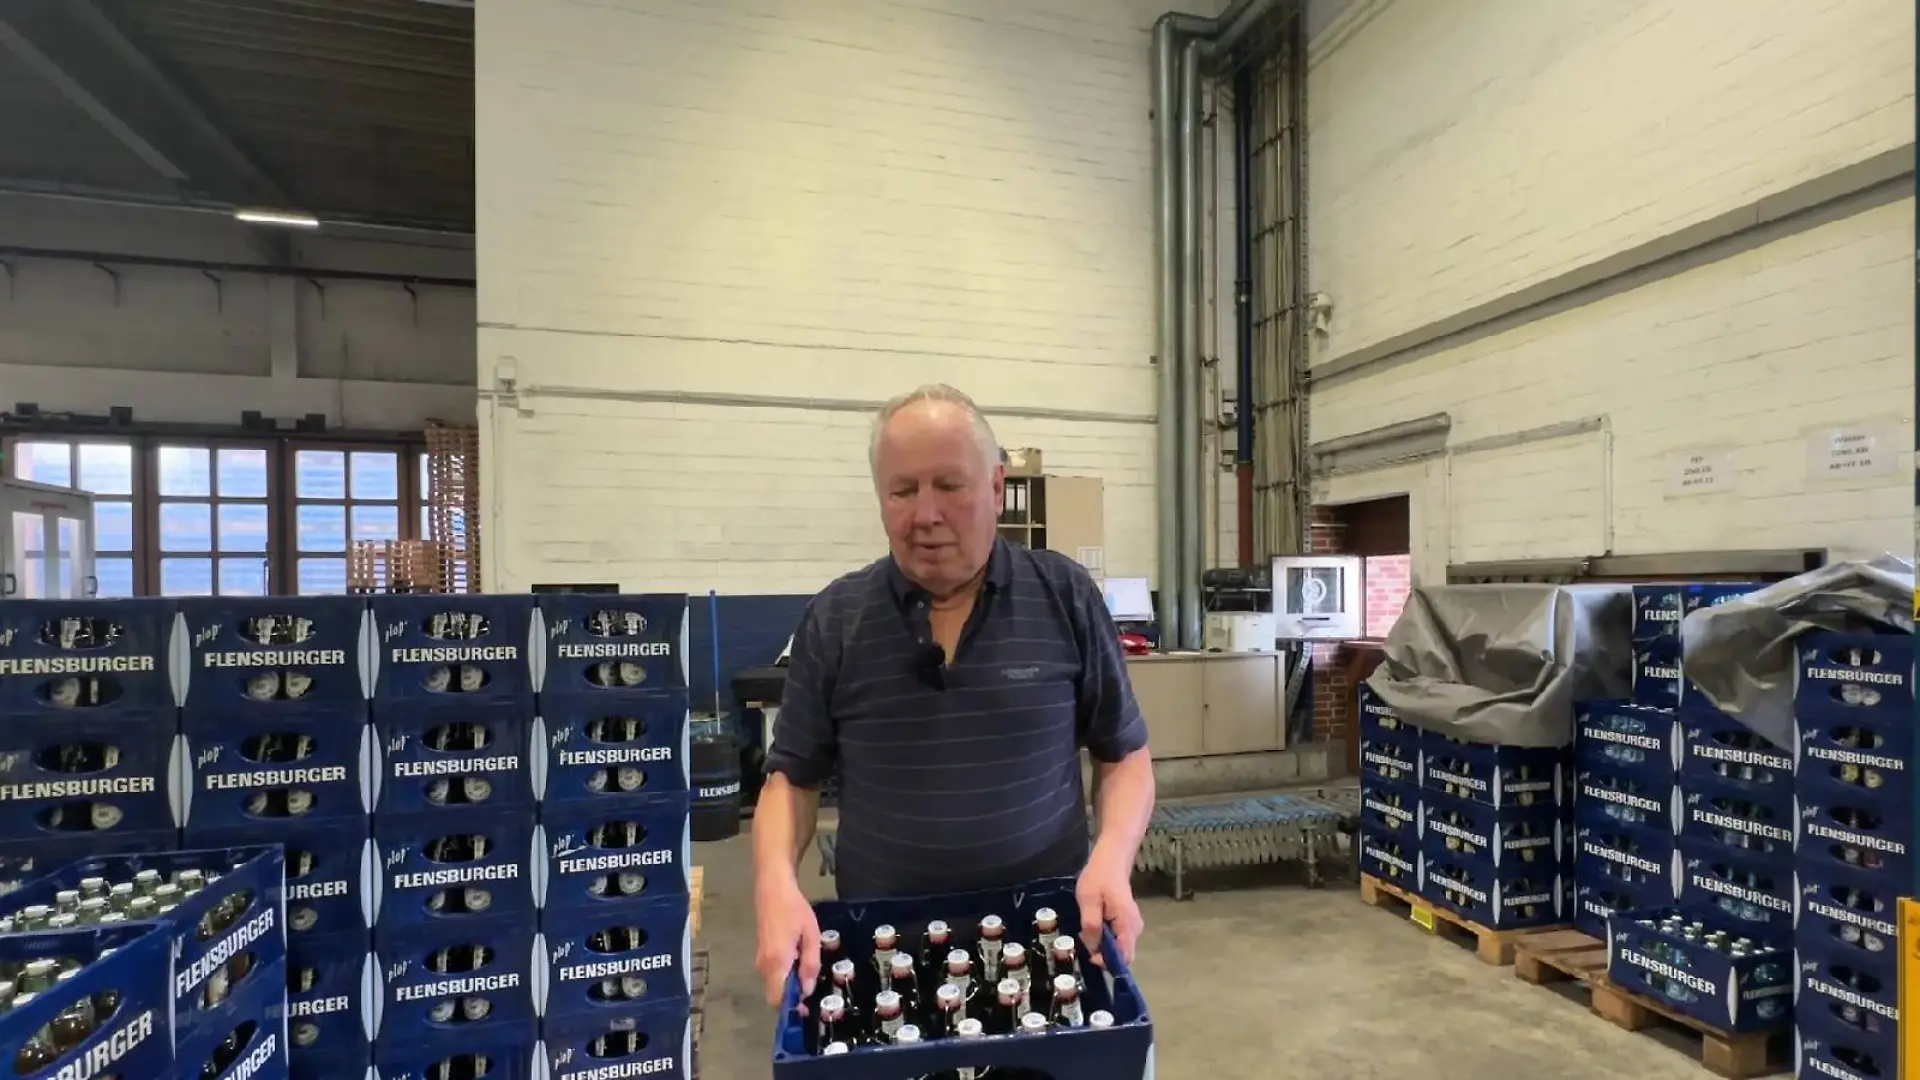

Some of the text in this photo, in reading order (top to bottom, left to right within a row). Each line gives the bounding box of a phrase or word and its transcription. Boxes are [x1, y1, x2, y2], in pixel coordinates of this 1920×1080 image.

[205, 650, 345, 668] FLENSBURGER
[392, 646, 517, 663] FLENSBURGER
[558, 643, 670, 659] FLENSBURGER
[0, 656, 155, 674] FLENSBURGER
[1807, 667, 1903, 685] FLENSBURGER
[1584, 727, 1661, 750] FLENSBURGER
[394, 756, 518, 777] FLENSBURGER
[559, 747, 672, 766] FLENSBURGER
[1693, 744, 1793, 770] FLENSBURGER
[1807, 746, 1904, 770] FLENSBURGER
[0, 777, 155, 800] FLENSBURGER
[206, 766, 346, 790] FLENSBURGER
[1584, 785, 1661, 812] FLENSBURGER
[1693, 809, 1793, 843] FLENSBURGER
[1807, 823, 1906, 855] FLENSBURGER
[560, 850, 673, 874] FLENSBURGER
[1584, 841, 1661, 875] FLENSBURGER
[394, 863, 518, 888] FLENSBURGER
[287, 880, 348, 900] URGER
[1693, 874, 1793, 913] FLENSBURGER
[1584, 900, 1616, 918] FLEN
[1808, 901, 1898, 936] FLENSBURGE
[176, 906, 274, 999] FLENSBURGER
[560, 954, 672, 980] FLENSBURGER
[1620, 948, 1717, 996] FLENSBURGER
[396, 974, 520, 1001] FLENSBURGER
[287, 996, 349, 1017] URGER
[47, 1010, 152, 1080] BURGER
